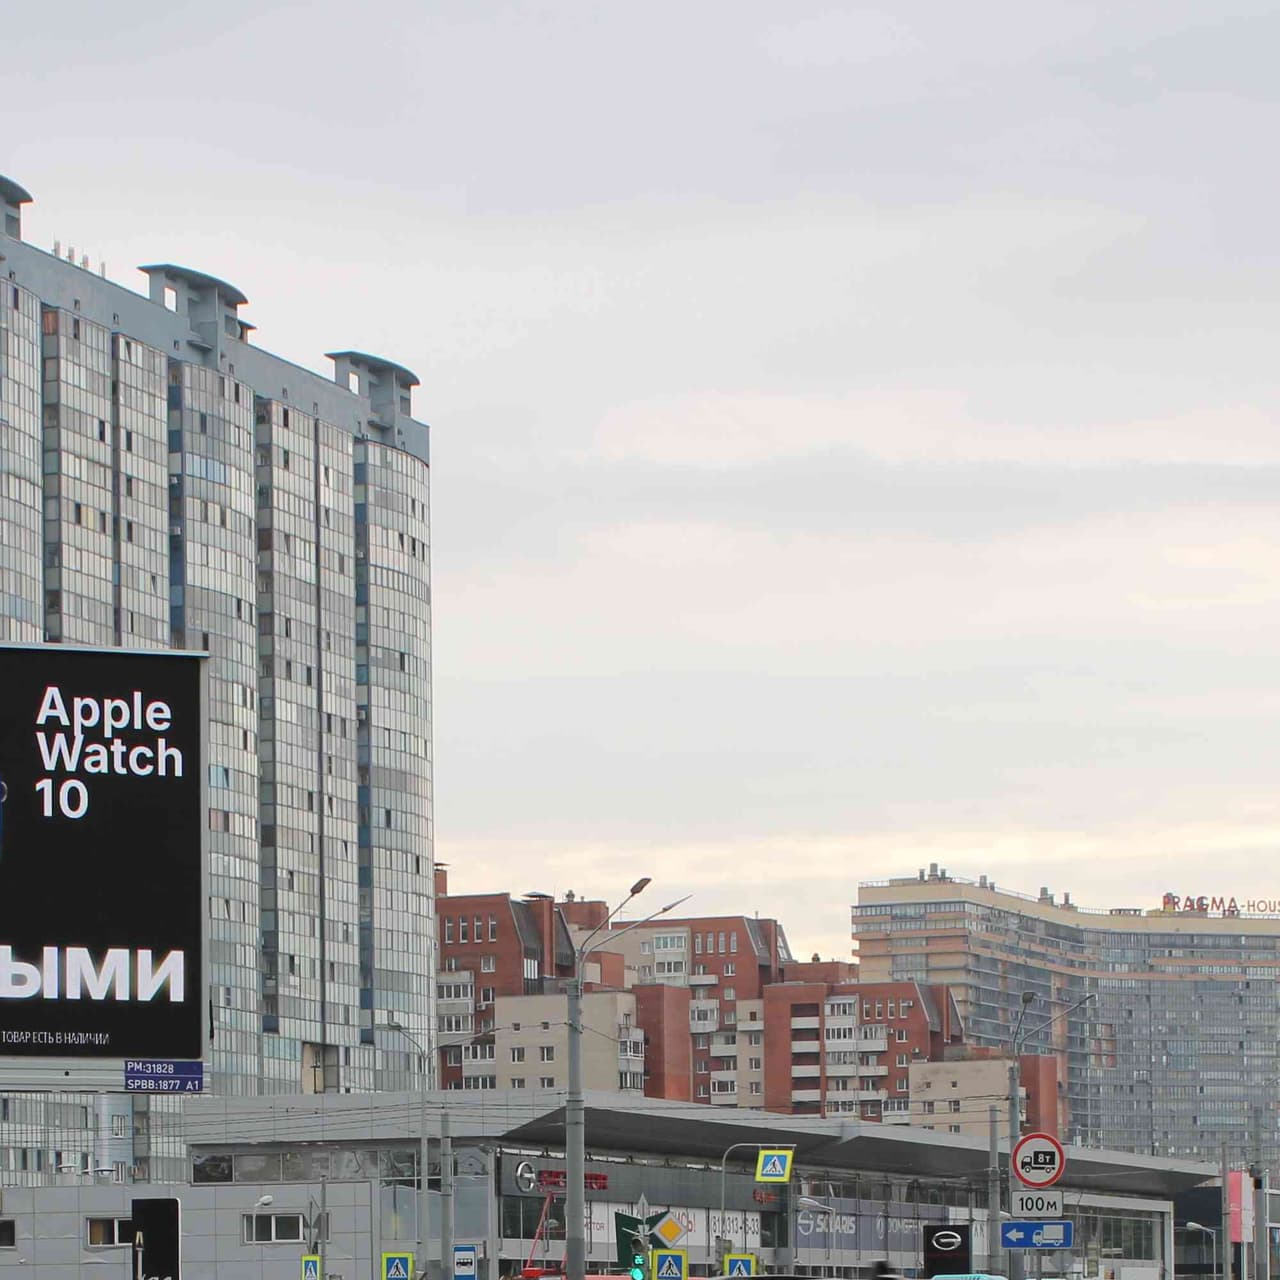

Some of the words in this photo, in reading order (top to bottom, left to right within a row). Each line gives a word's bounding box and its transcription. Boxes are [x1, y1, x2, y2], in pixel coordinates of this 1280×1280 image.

[35, 686, 172, 738] Apple
[36, 731, 183, 777] Watch
[35, 778, 89, 819] 10
[2, 1031, 31, 1044] ТОВАР
[32, 1031, 55, 1044] ЕСТЬ
[64, 1032, 111, 1046] НАЛИЧИИ
[127, 1079, 181, 1090] SPBB:1877
[185, 1080, 199, 1091] A1
